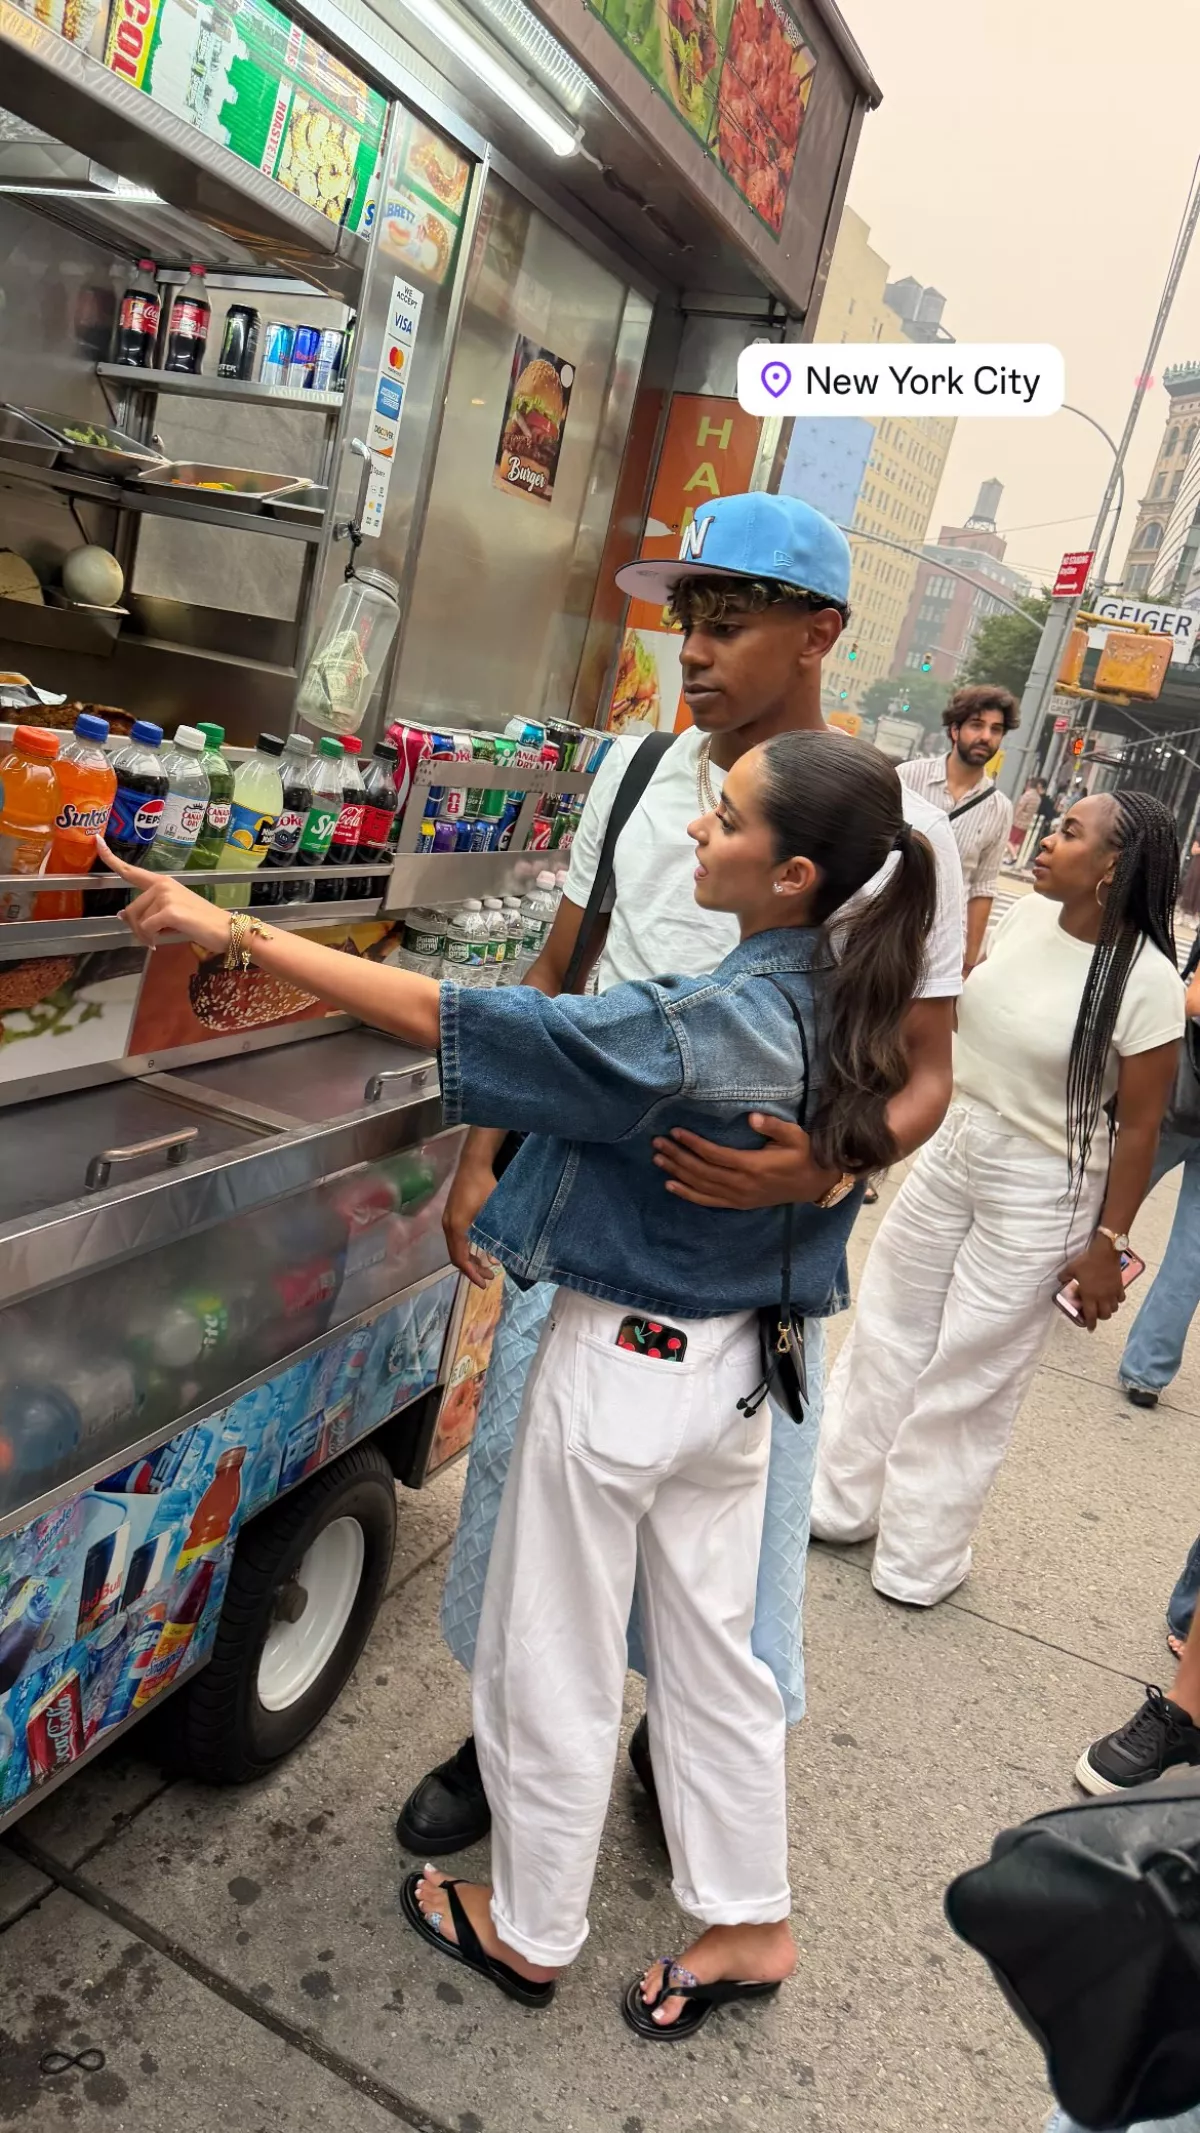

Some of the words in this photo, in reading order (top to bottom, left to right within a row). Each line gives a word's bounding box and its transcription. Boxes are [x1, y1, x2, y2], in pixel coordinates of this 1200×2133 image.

[396, 290, 418, 309] ACCEPT
[404, 285, 413, 297] WE
[395, 312, 413, 335] VISA
[507, 454, 546, 492] Burger
[1100, 603, 1193, 637] GEIGER
[137, 812, 162, 825] PEPS
